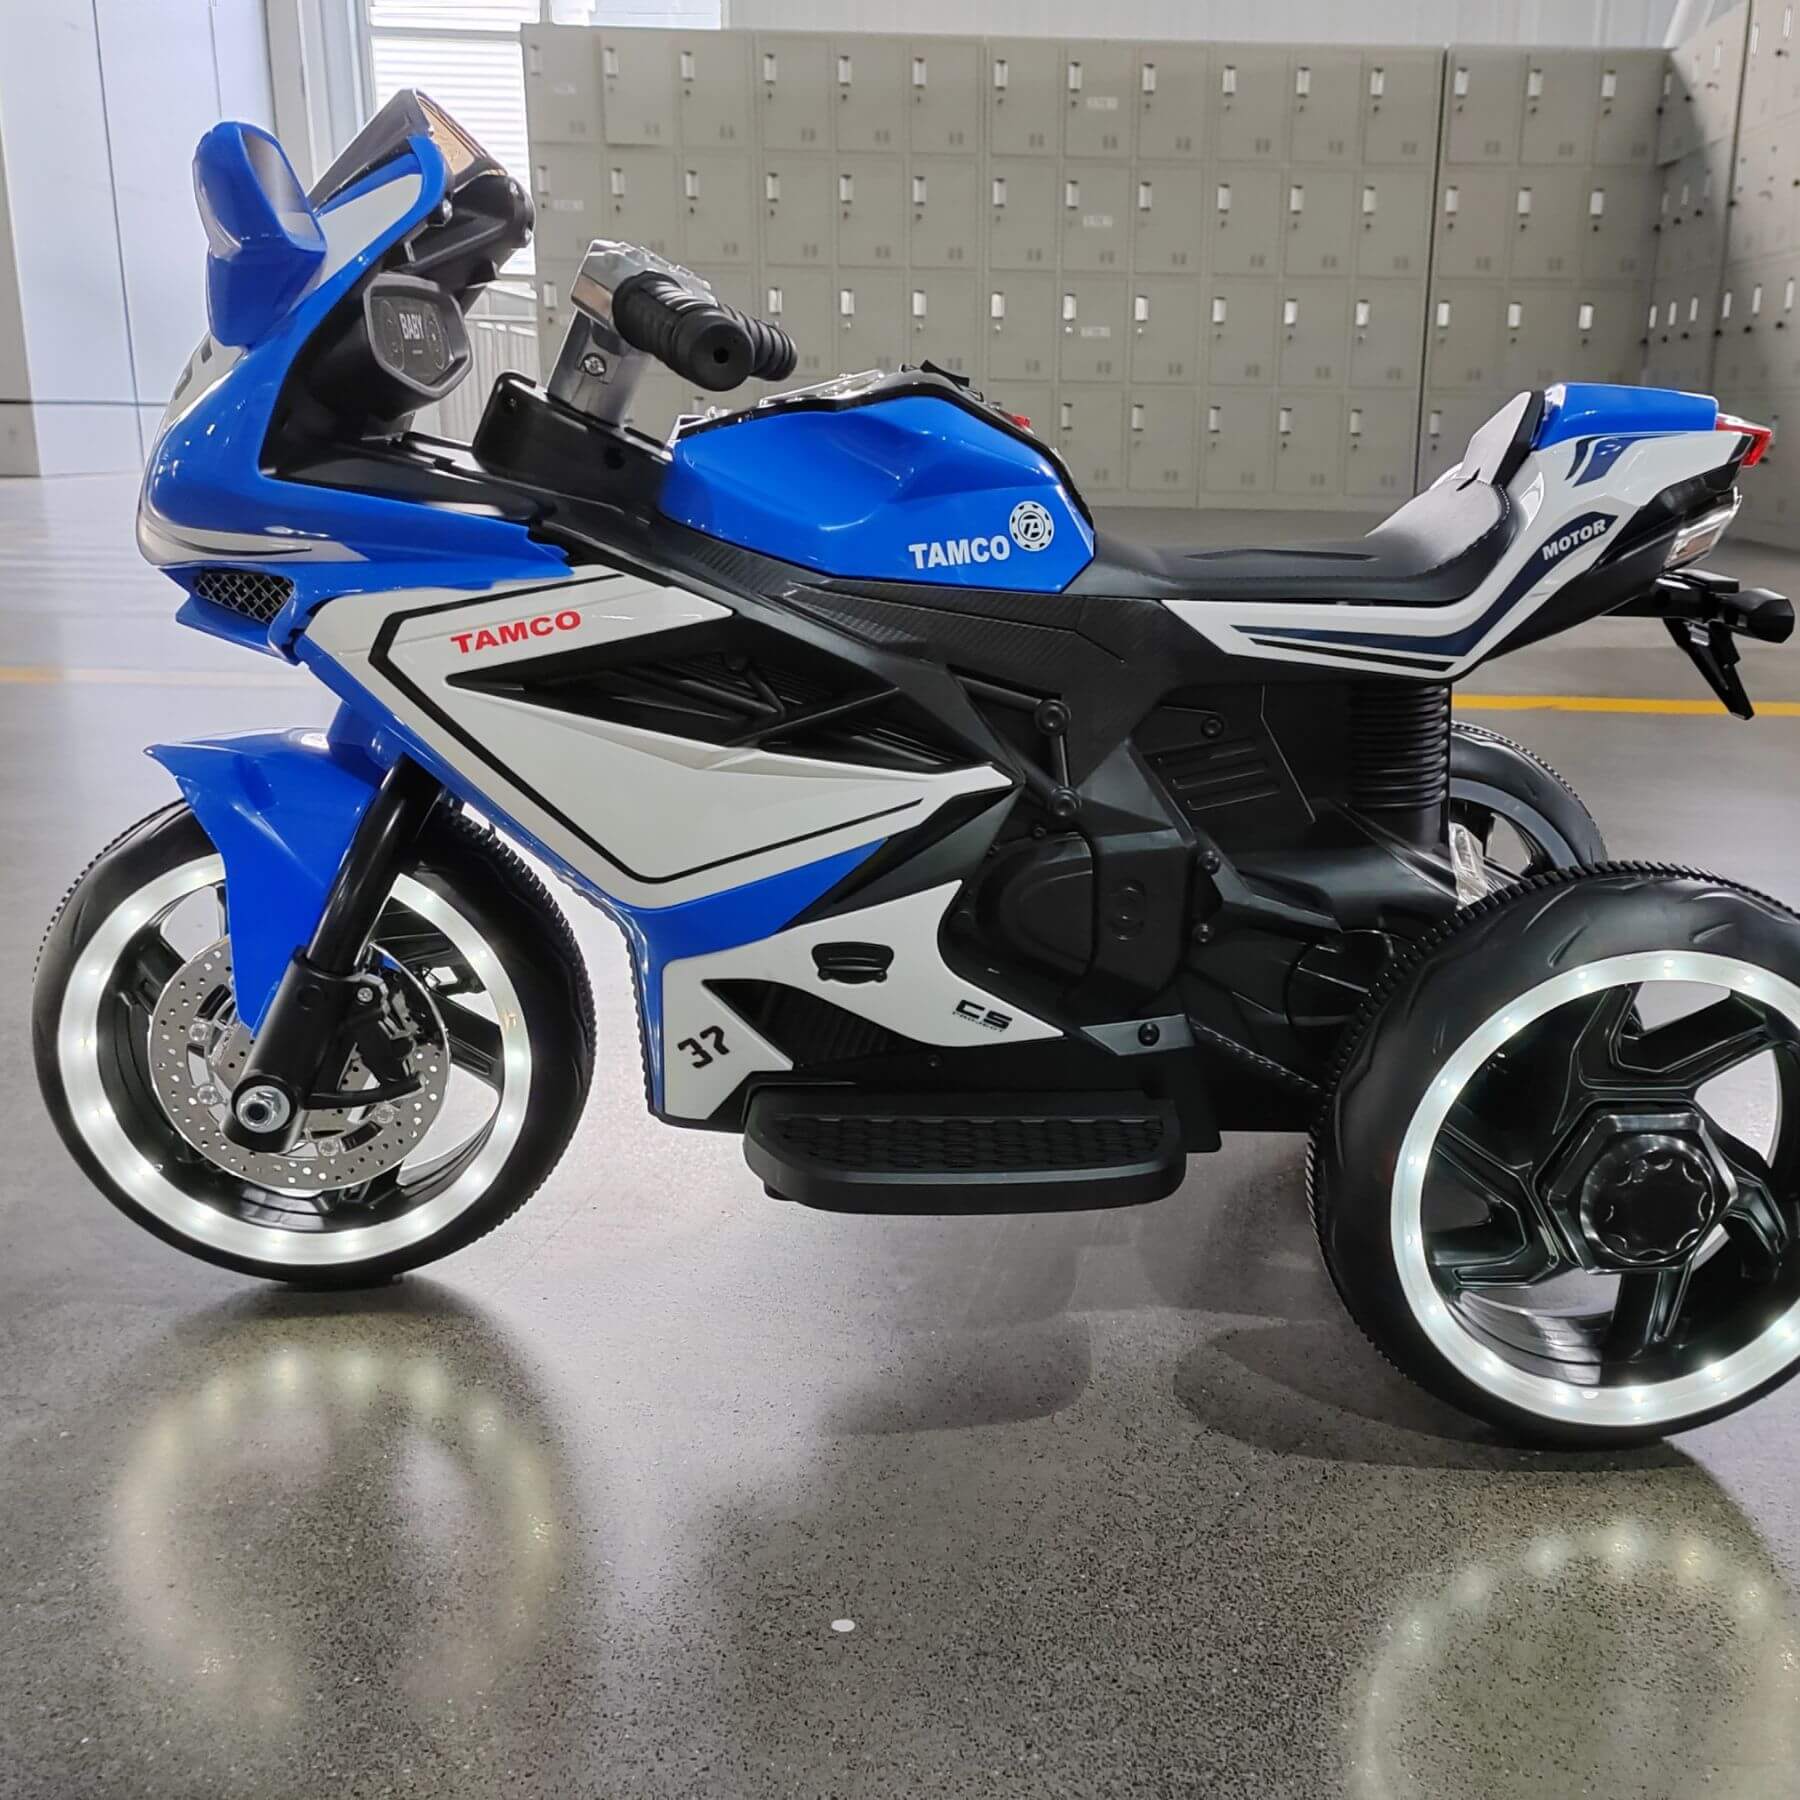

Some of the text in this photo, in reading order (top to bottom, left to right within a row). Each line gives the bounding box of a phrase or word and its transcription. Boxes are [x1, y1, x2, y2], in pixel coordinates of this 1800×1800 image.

[399, 313, 425, 340] BABY
[908, 535, 1010, 569] TAMCO
[1542, 519, 1607, 561] MOTOR
[450, 610, 581, 654] TAMCO
[956, 1000, 1013, 1029] CS
[677, 1025, 730, 1069] 37
